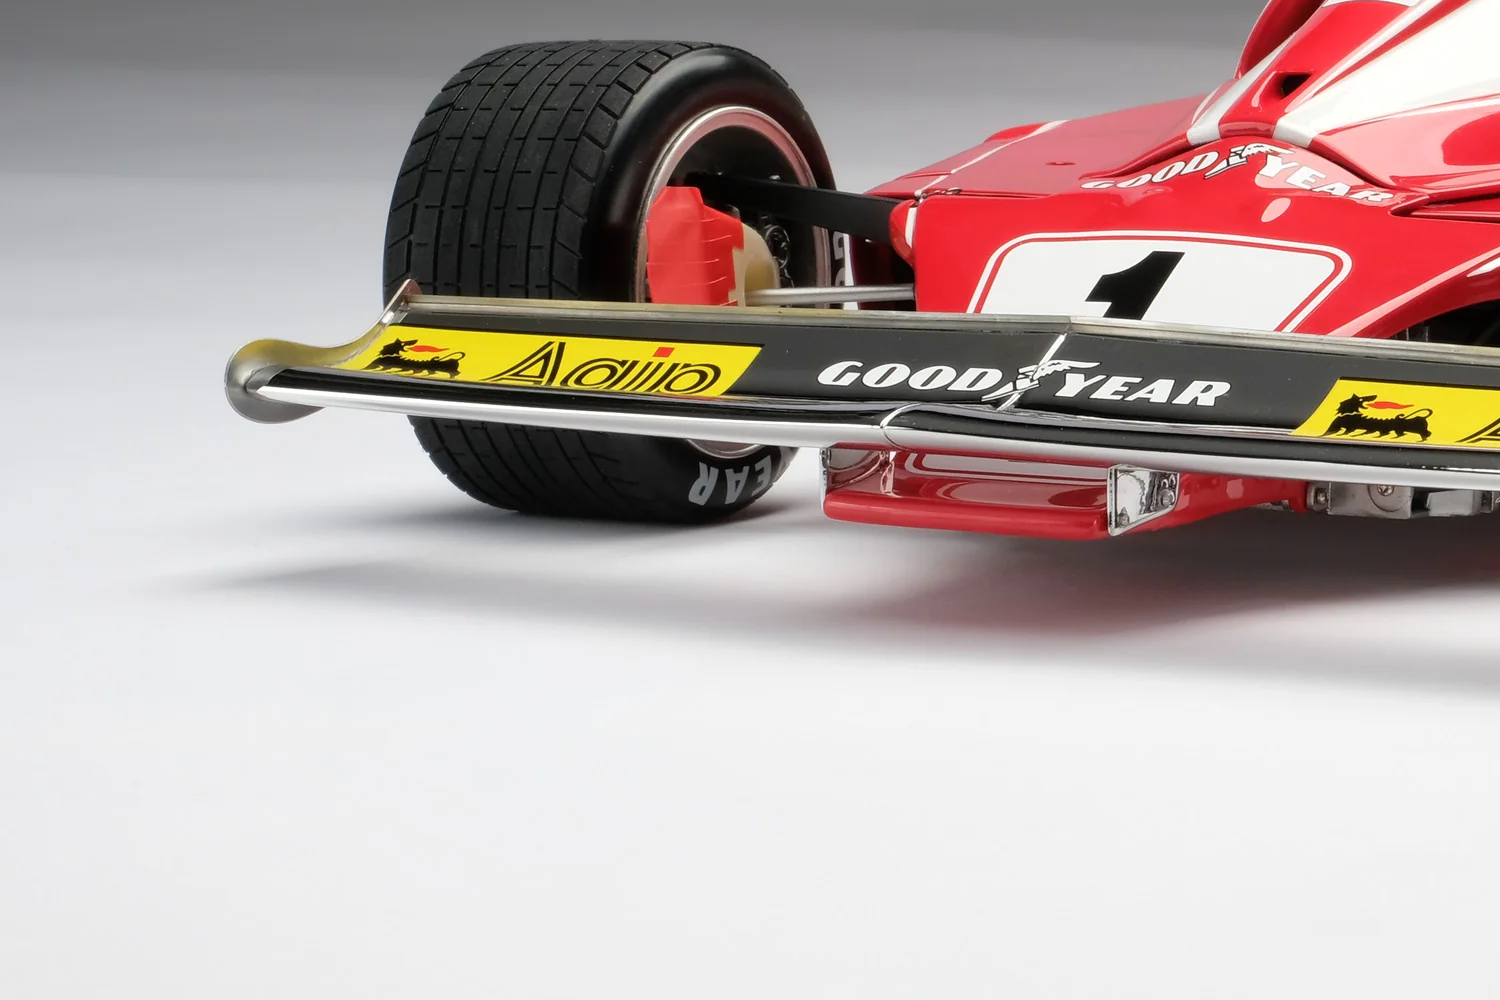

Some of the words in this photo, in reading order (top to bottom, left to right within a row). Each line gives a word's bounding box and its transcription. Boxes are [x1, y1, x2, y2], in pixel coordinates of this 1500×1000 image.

[1080, 151, 1219, 189] GOOD
[1258, 154, 1395, 202] YEAR
[1084, 250, 1186, 321] 1
[816, 360, 1003, 393] GOOD
[1054, 372, 1231, 407] YEAR
